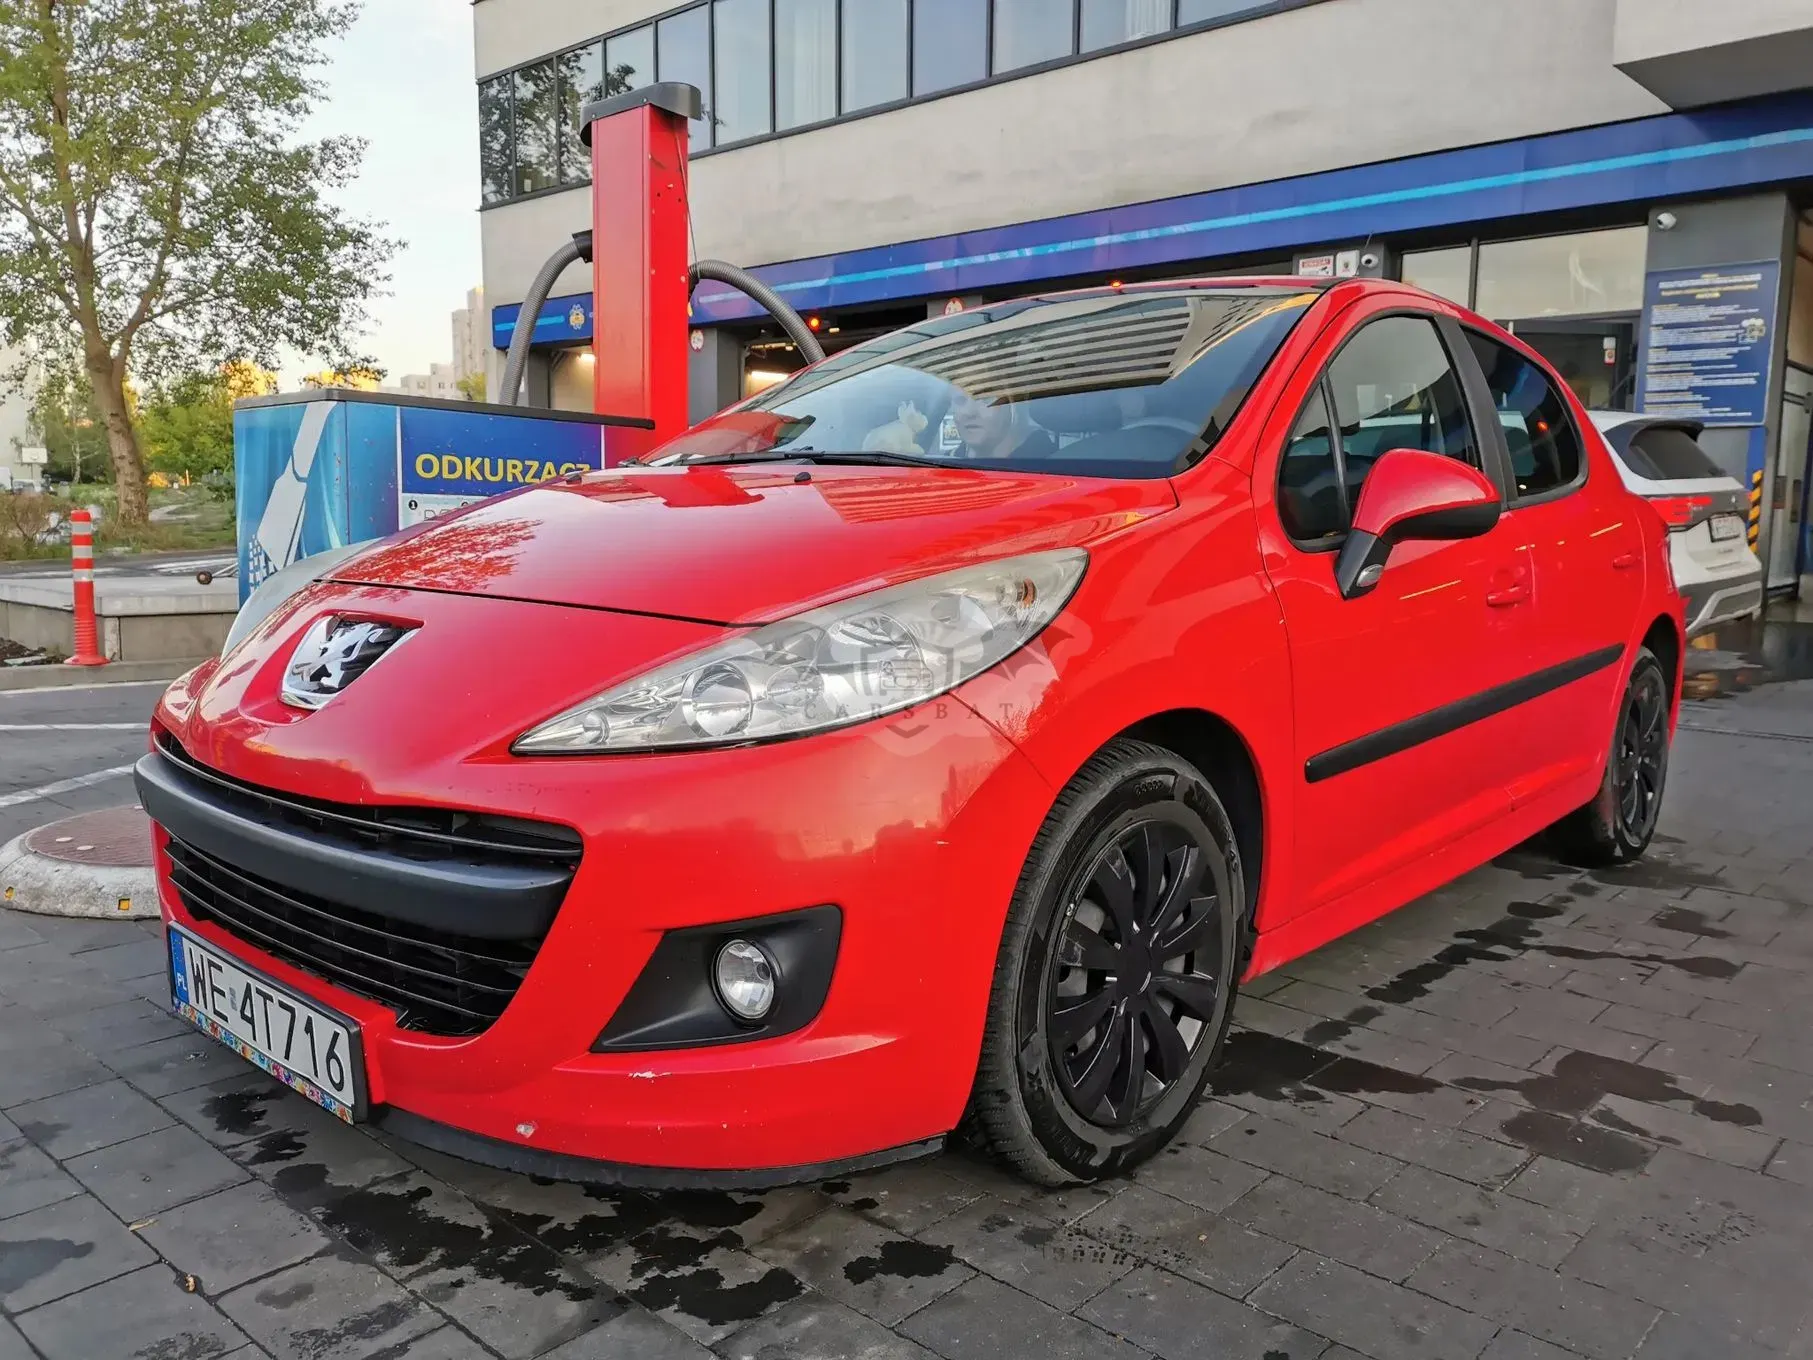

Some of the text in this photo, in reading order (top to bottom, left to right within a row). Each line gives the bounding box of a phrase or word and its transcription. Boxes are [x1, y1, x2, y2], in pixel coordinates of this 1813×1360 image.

[176, 972, 188, 991] PL
[189, 947, 345, 1092] WE 4T716
